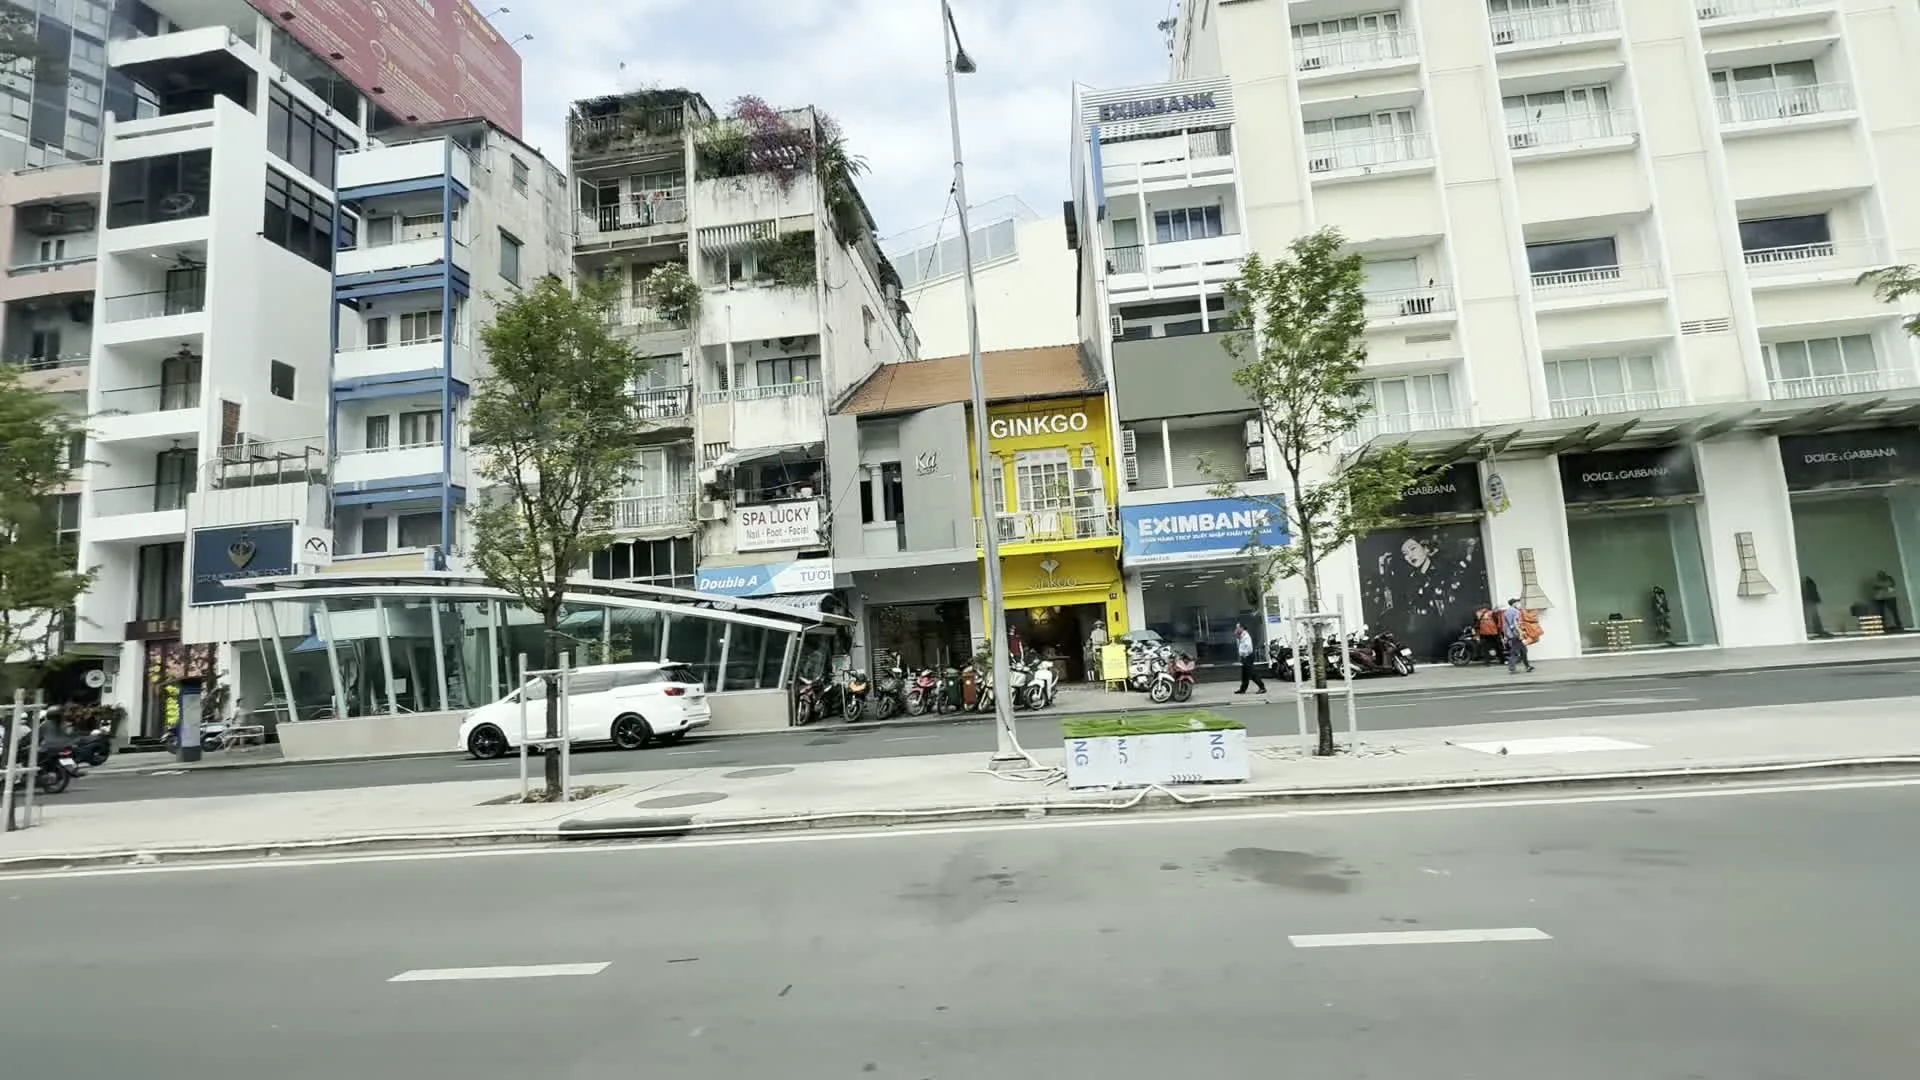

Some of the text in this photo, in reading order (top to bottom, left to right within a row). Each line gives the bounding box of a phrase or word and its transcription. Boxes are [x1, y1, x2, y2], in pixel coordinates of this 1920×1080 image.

[1099, 91, 1217, 121] EXIMBANK
[990, 412, 1088, 439] GINKGO
[1804, 452, 1838, 464] DOLCE
[1843, 447, 1897, 460] GABBANA
[1407, 484, 1457, 496] GABBANA
[742, 506, 812, 527] SPA LUCKY
[1138, 508, 1271, 537] EXIMBANK
[700, 575, 759, 590] Double A
